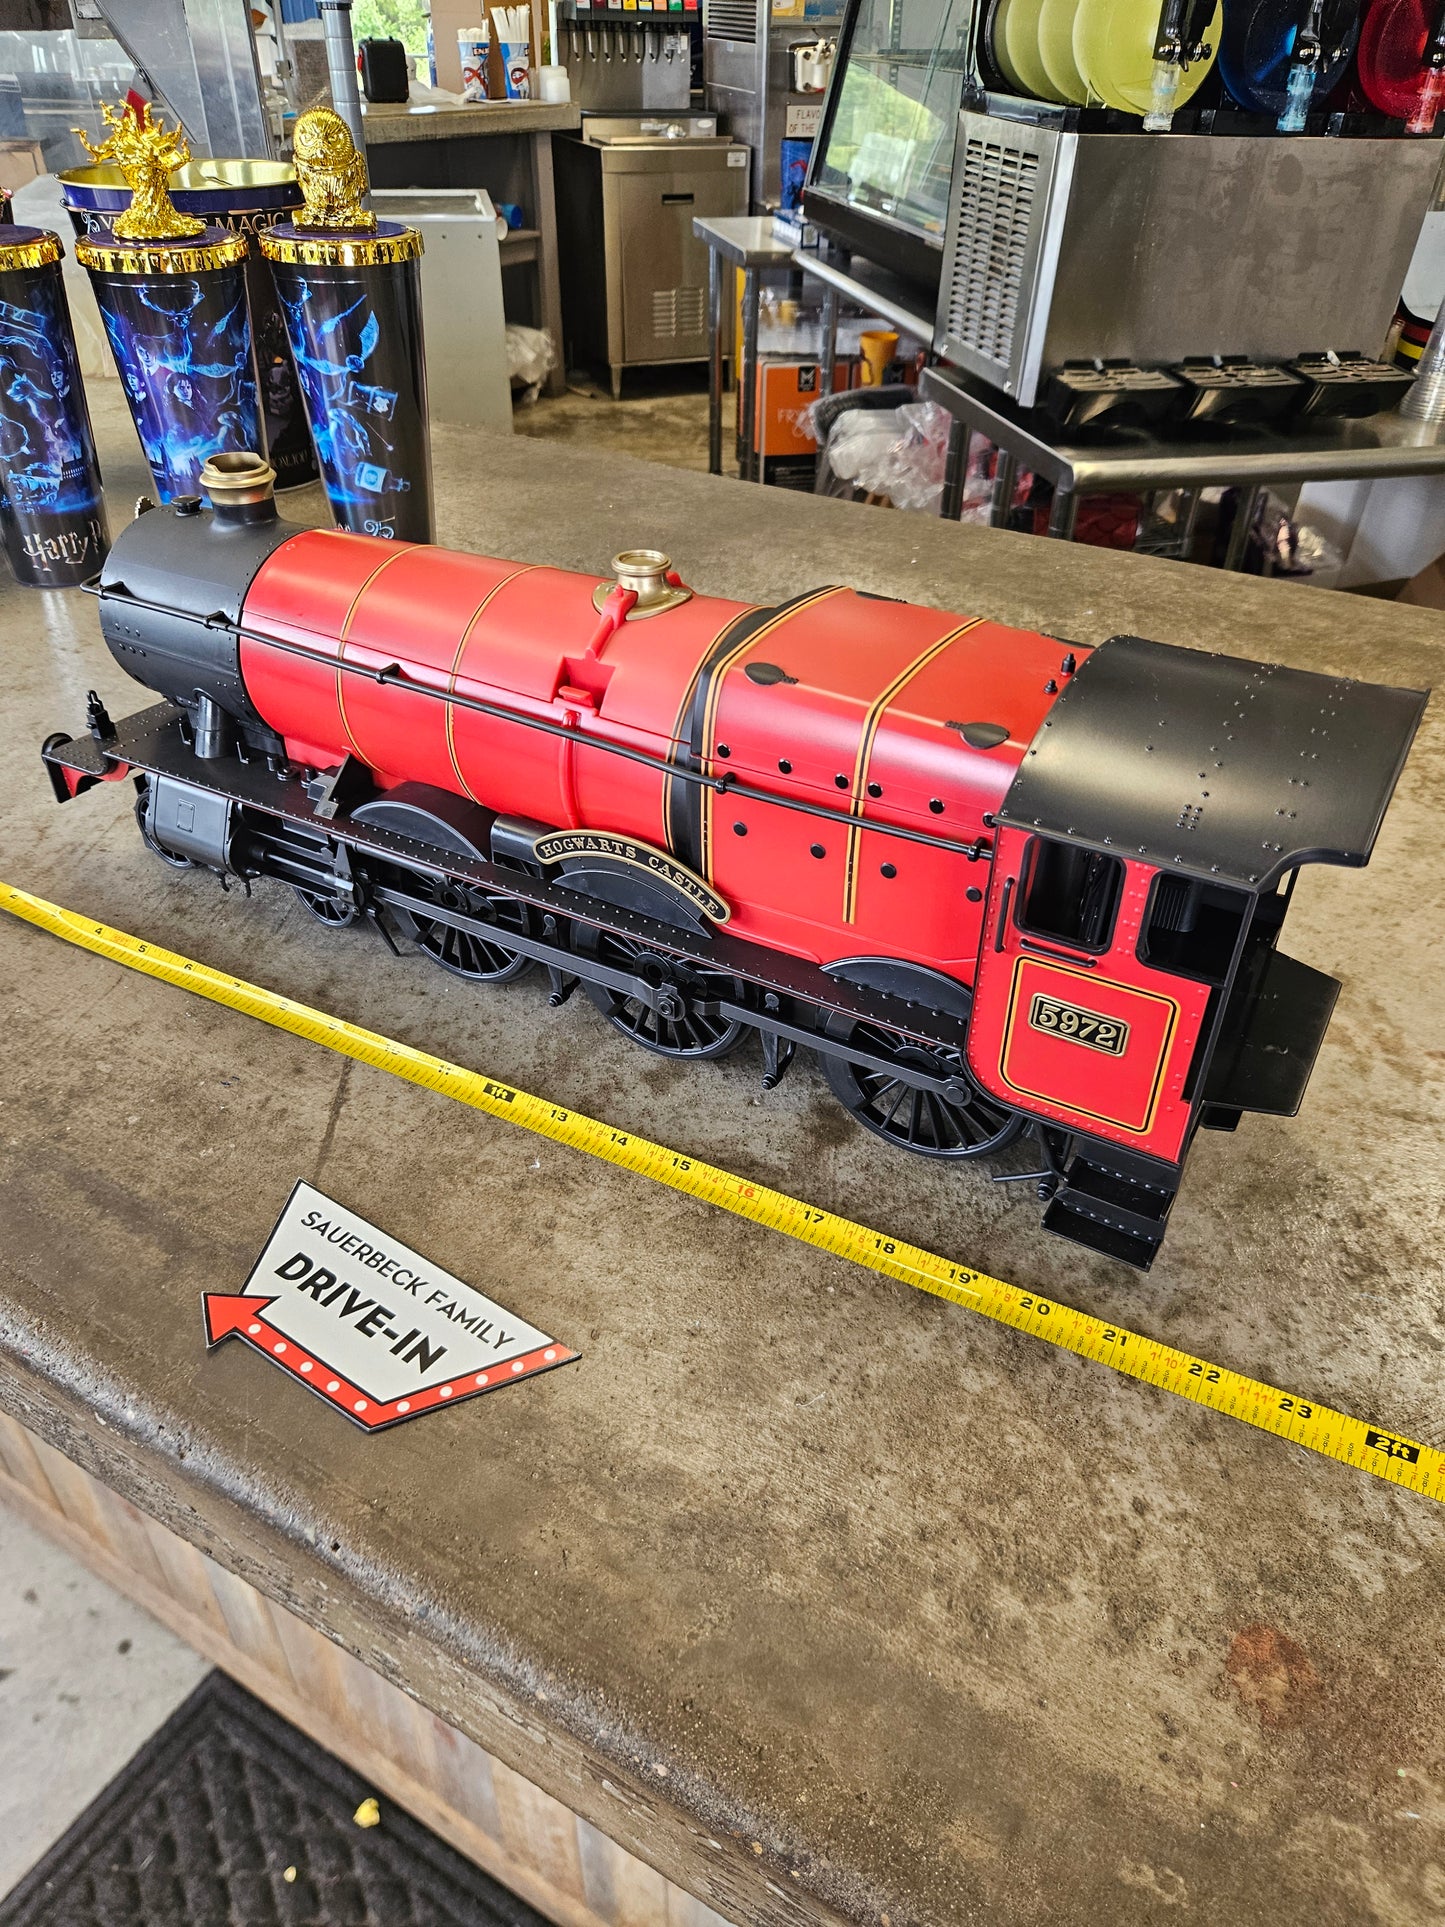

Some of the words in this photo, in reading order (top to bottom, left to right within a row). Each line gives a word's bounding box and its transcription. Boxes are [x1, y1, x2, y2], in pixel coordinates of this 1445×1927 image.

[801, 123, 815, 134] THE
[214, 211, 285, 235] MAGIC
[23, 532, 89, 572] Harry
[540, 836, 637, 859] HOGWARTS
[649, 856, 719, 914] CASTLE
[1038, 1003, 1117, 1048] 5972
[138, 944, 147, 953] 5
[491, 1085, 508, 1101] 1ft
[550, 1109, 568, 1122] 13
[610, 1132, 628, 1146] 14
[672, 1157, 691, 1171] 15
[737, 1185, 755, 1198] 16
[803, 1210, 825, 1224] 17
[874, 1238, 896, 1254] 18
[1019, 1297, 1051, 1316] 20
[1102, 1329, 1128, 1347] 21
[1188, 1363, 1221, 1384] 22
[1278, 1398, 1313, 1419] 23
[1374, 1435, 1411, 1459] 2ft
[301, 1210, 429, 1297] SAUERBECK
[424, 1289, 516, 1350] FAMILY
[274, 1252, 448, 1374] DRIVE-IN
